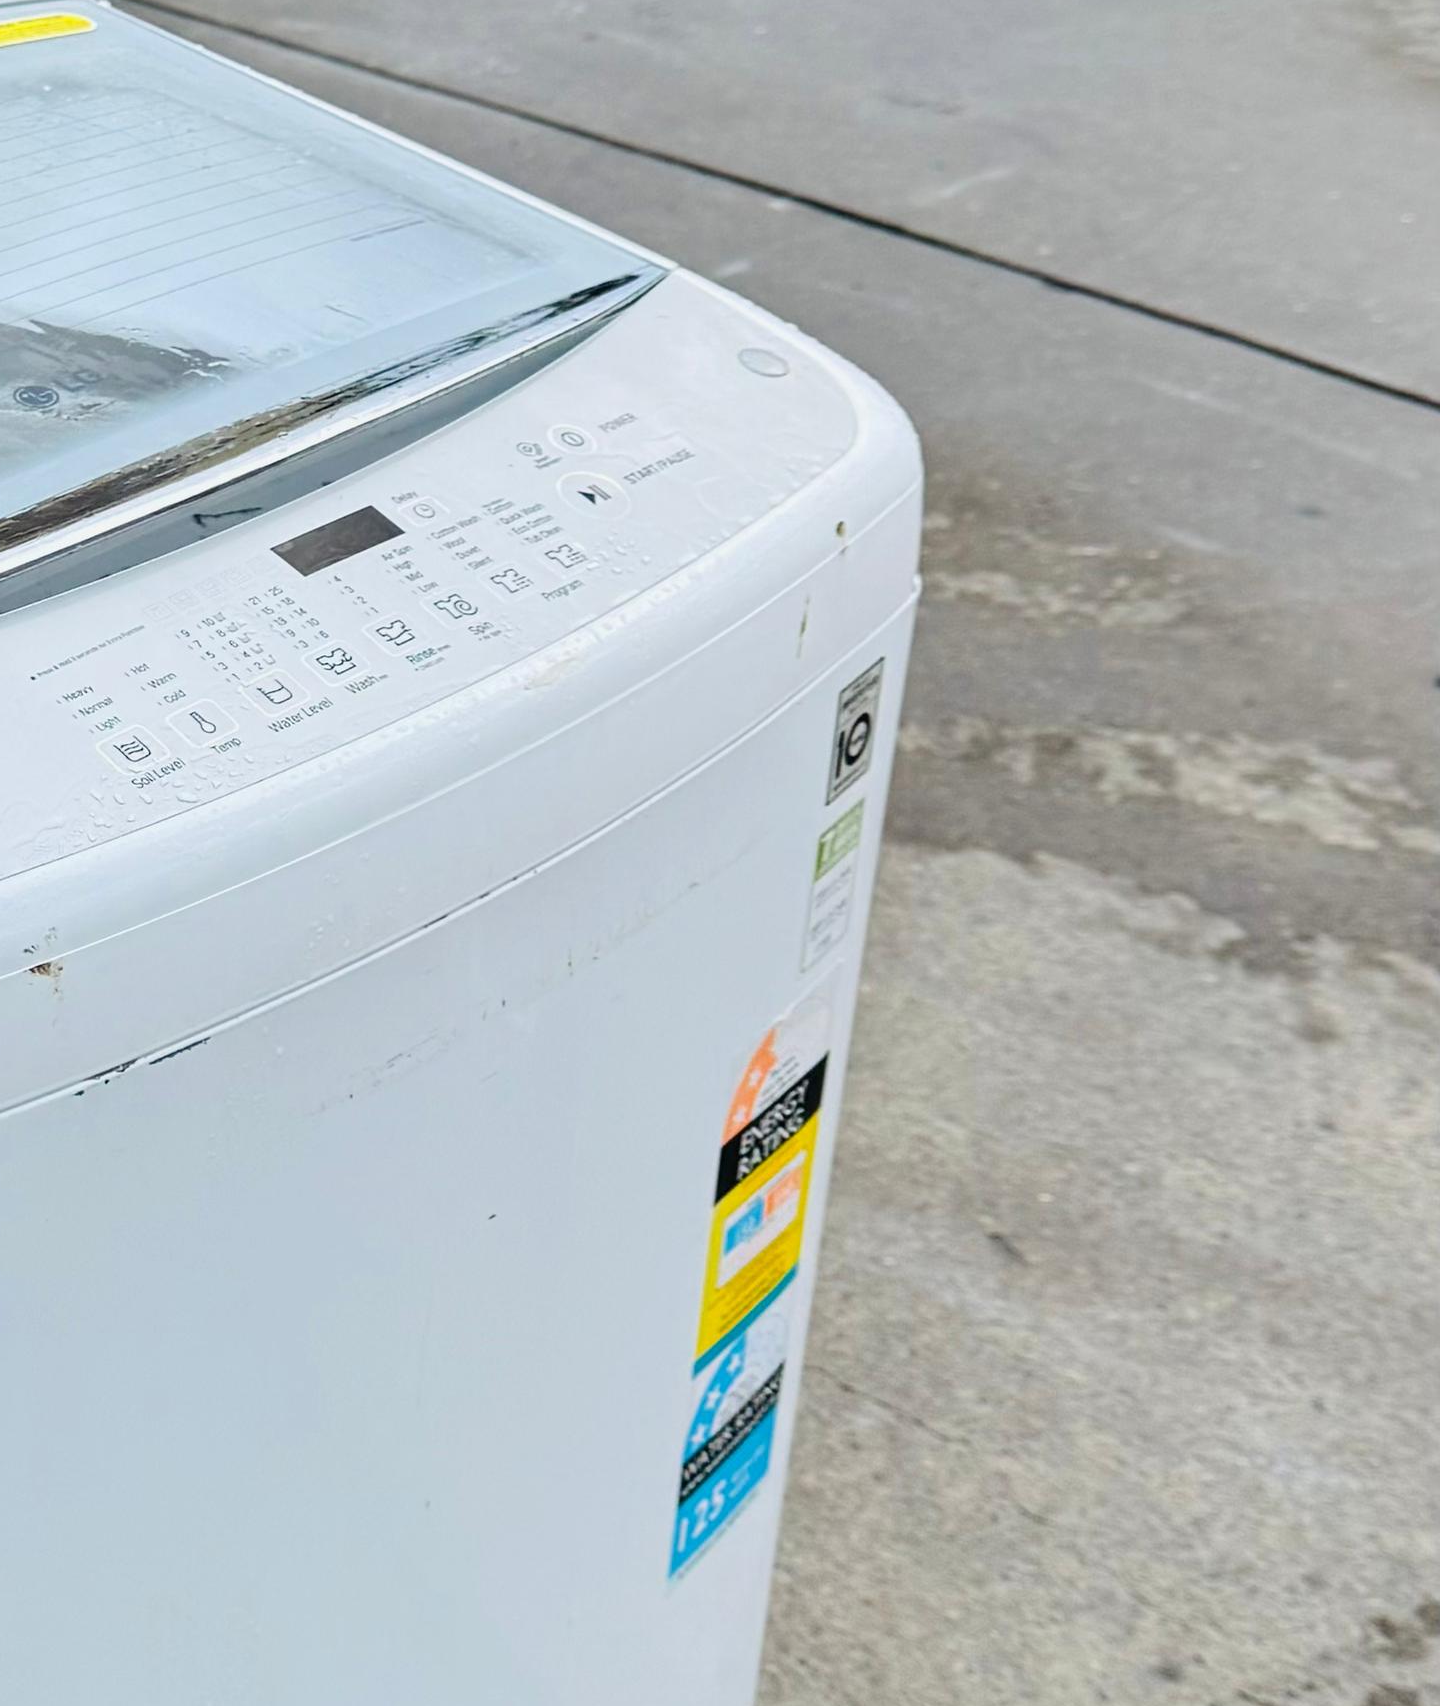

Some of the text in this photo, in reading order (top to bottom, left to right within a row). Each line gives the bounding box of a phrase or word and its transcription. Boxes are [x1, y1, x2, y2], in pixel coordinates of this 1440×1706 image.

[598, 412, 639, 433] POWER
[623, 448, 697, 485] START/PAUSE
[248, 586, 284, 606] 21 25
[261, 606, 275, 615] 15
[293, 607, 307, 617] 14
[202, 617, 215, 627] 10
[306, 617, 320, 627] 10
[468, 622, 494, 636] Spin
[405, 647, 438, 665] Rinse
[130, 662, 150, 676] Hot
[147, 672, 177, 689] Warm
[345, 674, 380, 694] Wash
[62, 685, 94, 703] Heavy
[163, 689, 186, 704] Cold
[78, 696, 114, 716] Normal
[268, 697, 334, 733] Water Level
[95, 715, 122, 733] Light
[210, 737, 242, 755] Temp
[131, 757, 187, 789] Soil Level
